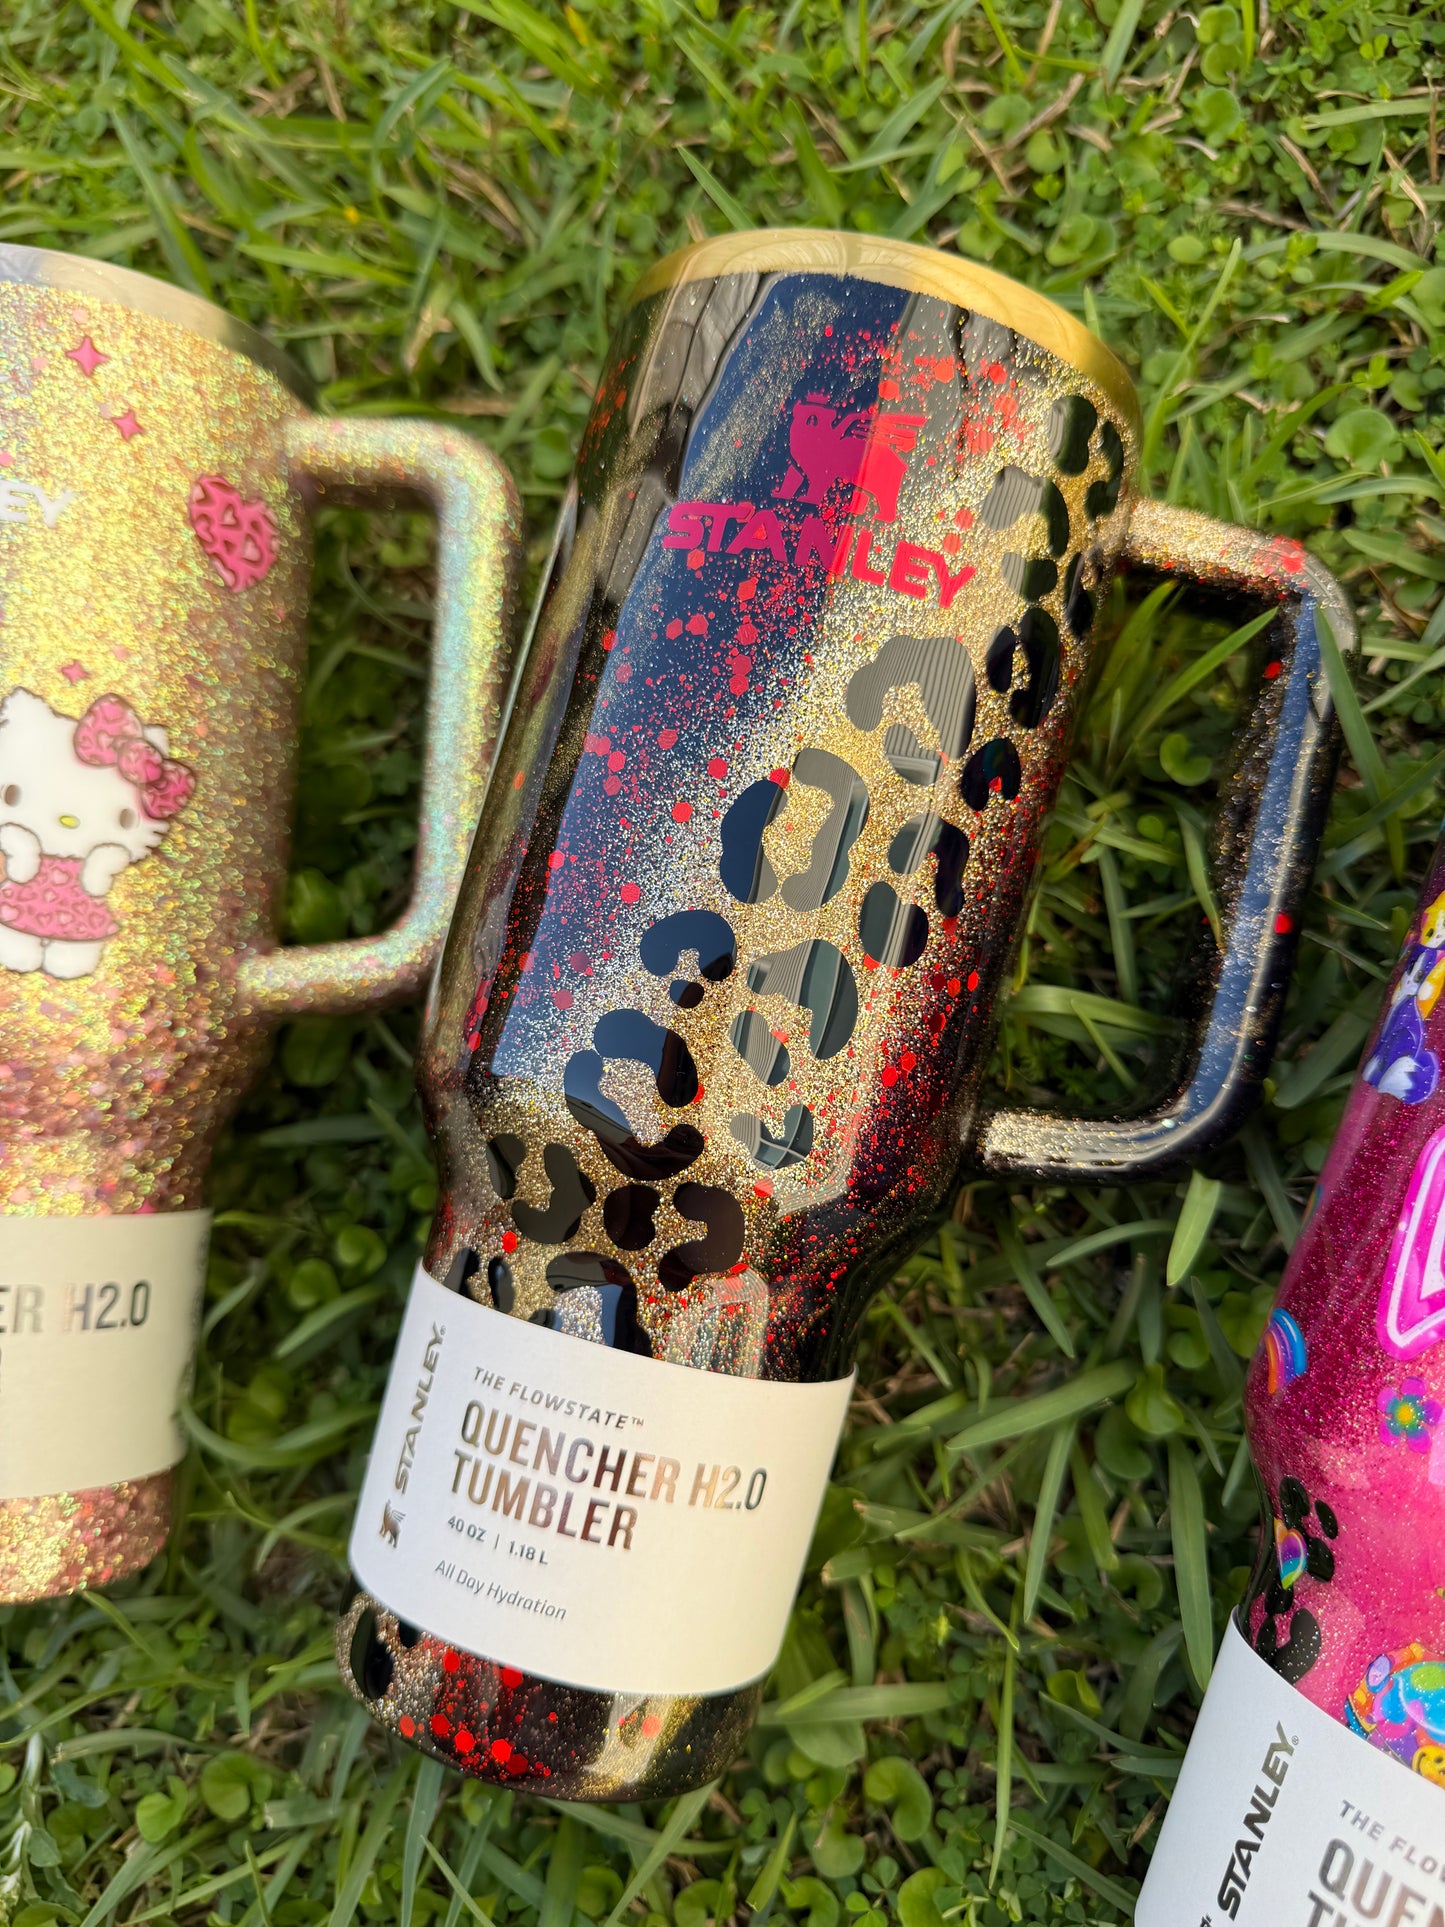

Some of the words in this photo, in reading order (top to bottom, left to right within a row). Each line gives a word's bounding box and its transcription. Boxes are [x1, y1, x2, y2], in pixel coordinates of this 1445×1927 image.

[662, 502, 977, 609] STANLEY
[63, 1280, 151, 1331] H2.0
[474, 1366, 505, 1390] THE
[461, 1399, 682, 1504] QUENCHER
[688, 1462, 768, 1511] H2.0
[451, 1449, 639, 1551] TUMBLER
[448, 1515, 465, 1533] 40
[467, 1524, 487, 1542] OZ
[509, 1540, 536, 1561] 1.18
[539, 1550, 549, 1565] L
[435, 1560, 456, 1579] All
[456, 1569, 485, 1594] Day
[487, 1582, 567, 1620] Hydration
[1340, 1799, 1385, 1841] THE
